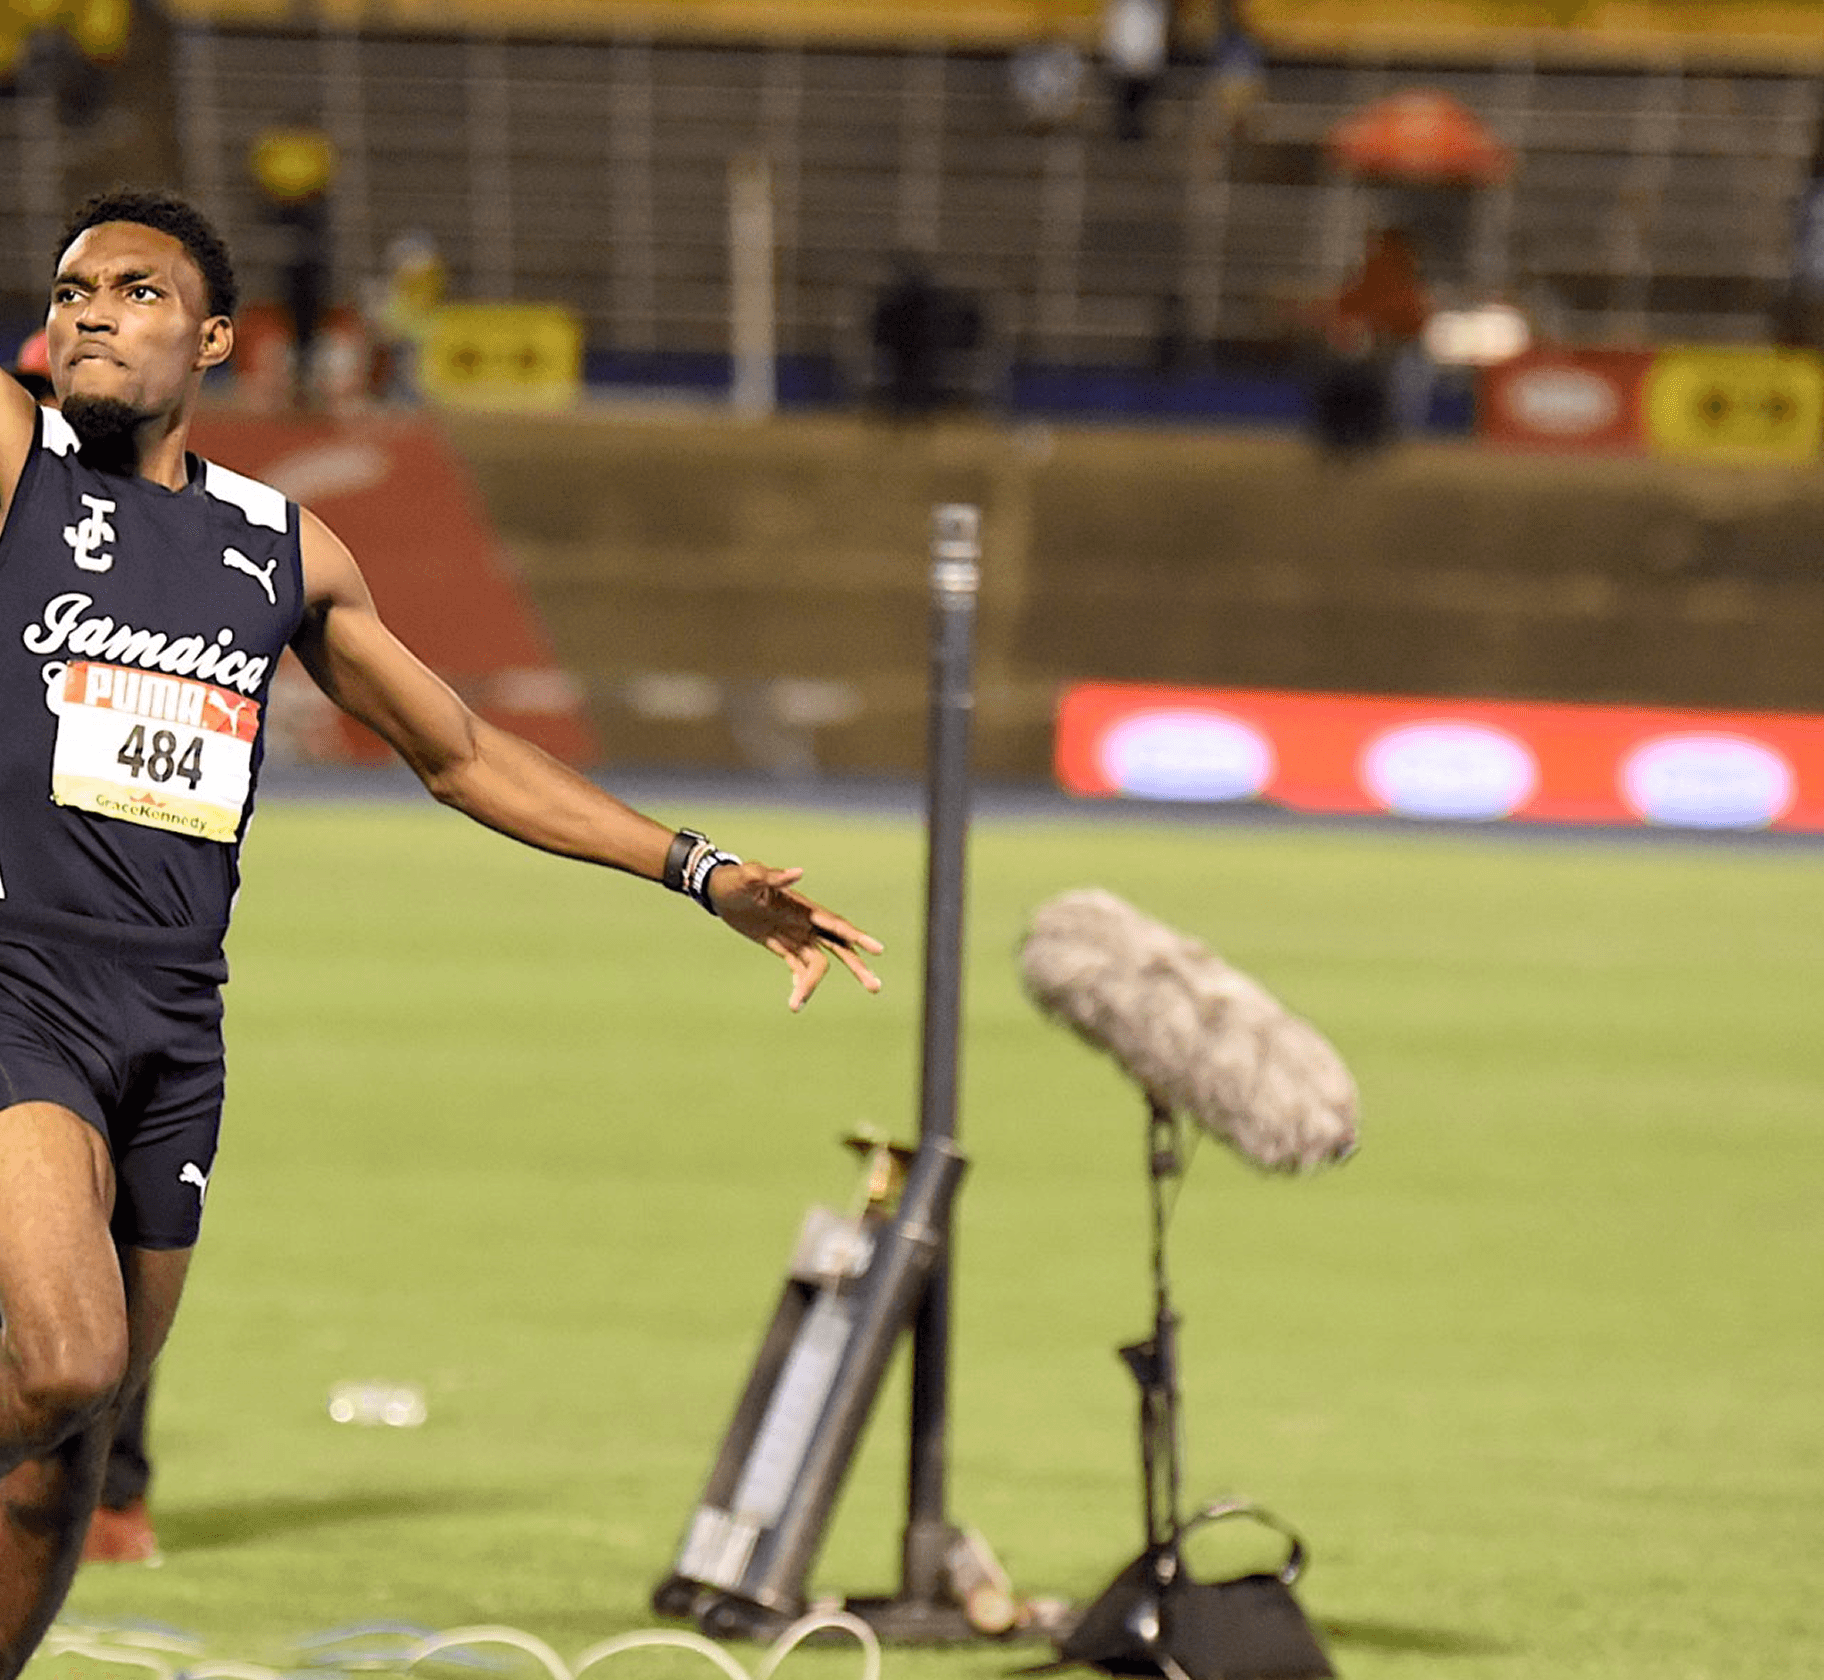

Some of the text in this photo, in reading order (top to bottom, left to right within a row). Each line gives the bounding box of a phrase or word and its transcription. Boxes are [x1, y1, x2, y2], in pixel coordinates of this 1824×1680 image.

[23, 593, 269, 694] Jamaica
[84, 666, 206, 728] PUMA
[116, 724, 204, 790] 484
[95, 793, 208, 832] GraceKennedy
